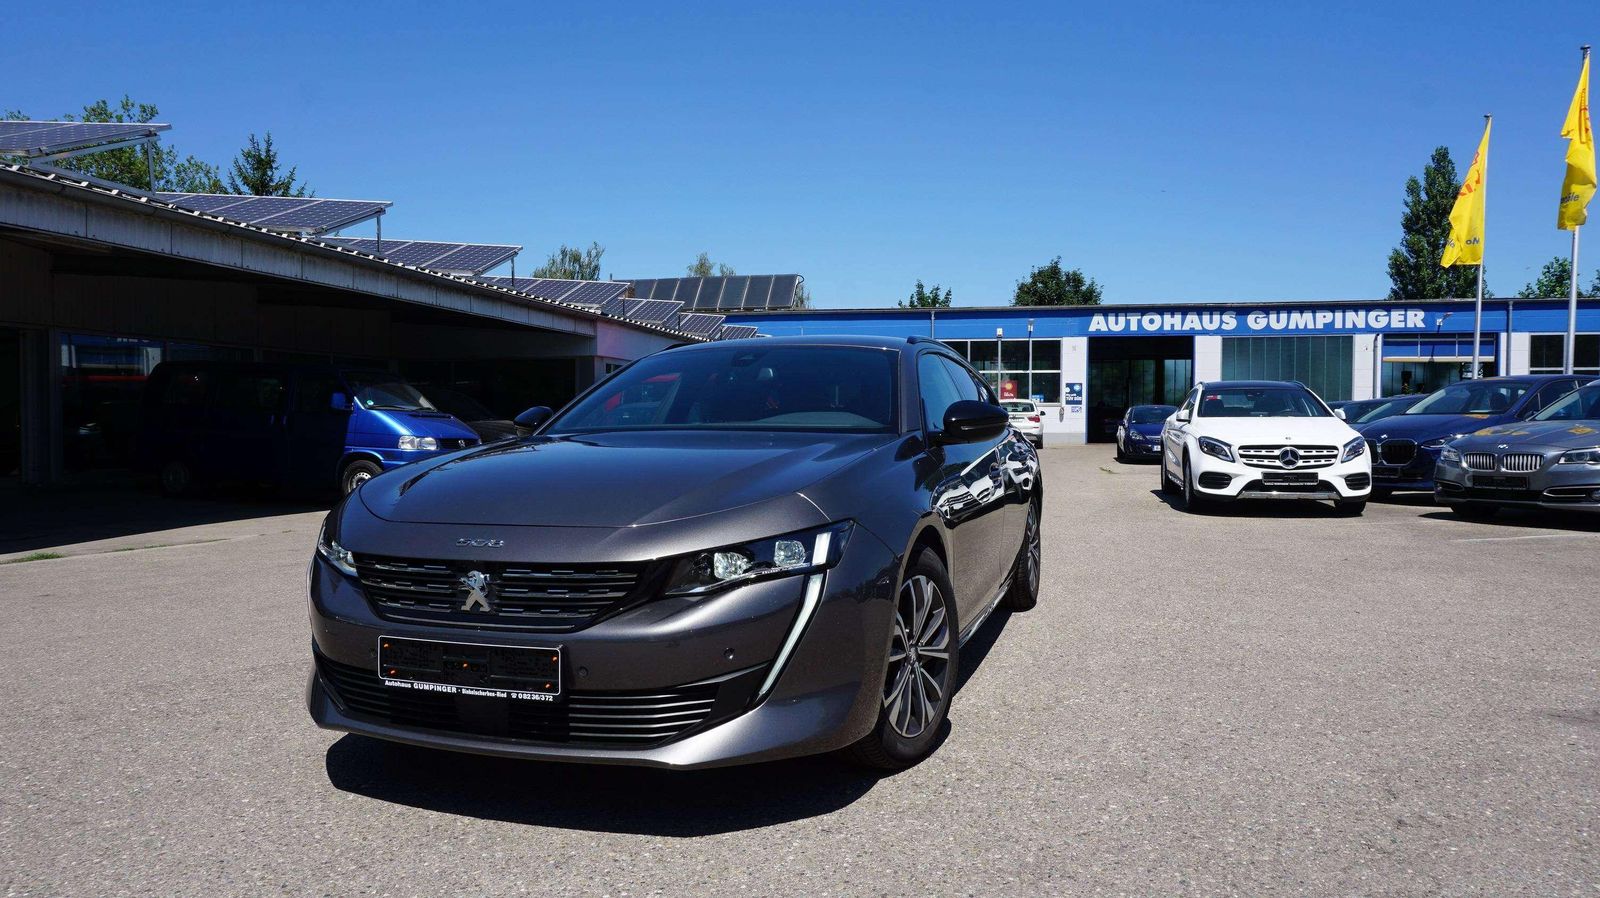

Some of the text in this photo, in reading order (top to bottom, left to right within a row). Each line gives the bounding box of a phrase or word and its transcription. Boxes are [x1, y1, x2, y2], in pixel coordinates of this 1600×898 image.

[1088, 308, 1426, 332] AUTOHAUS GUMPINGER
[385, 680, 412, 688] Autohaus
[413, 682, 457, 694] GUMPINGER
